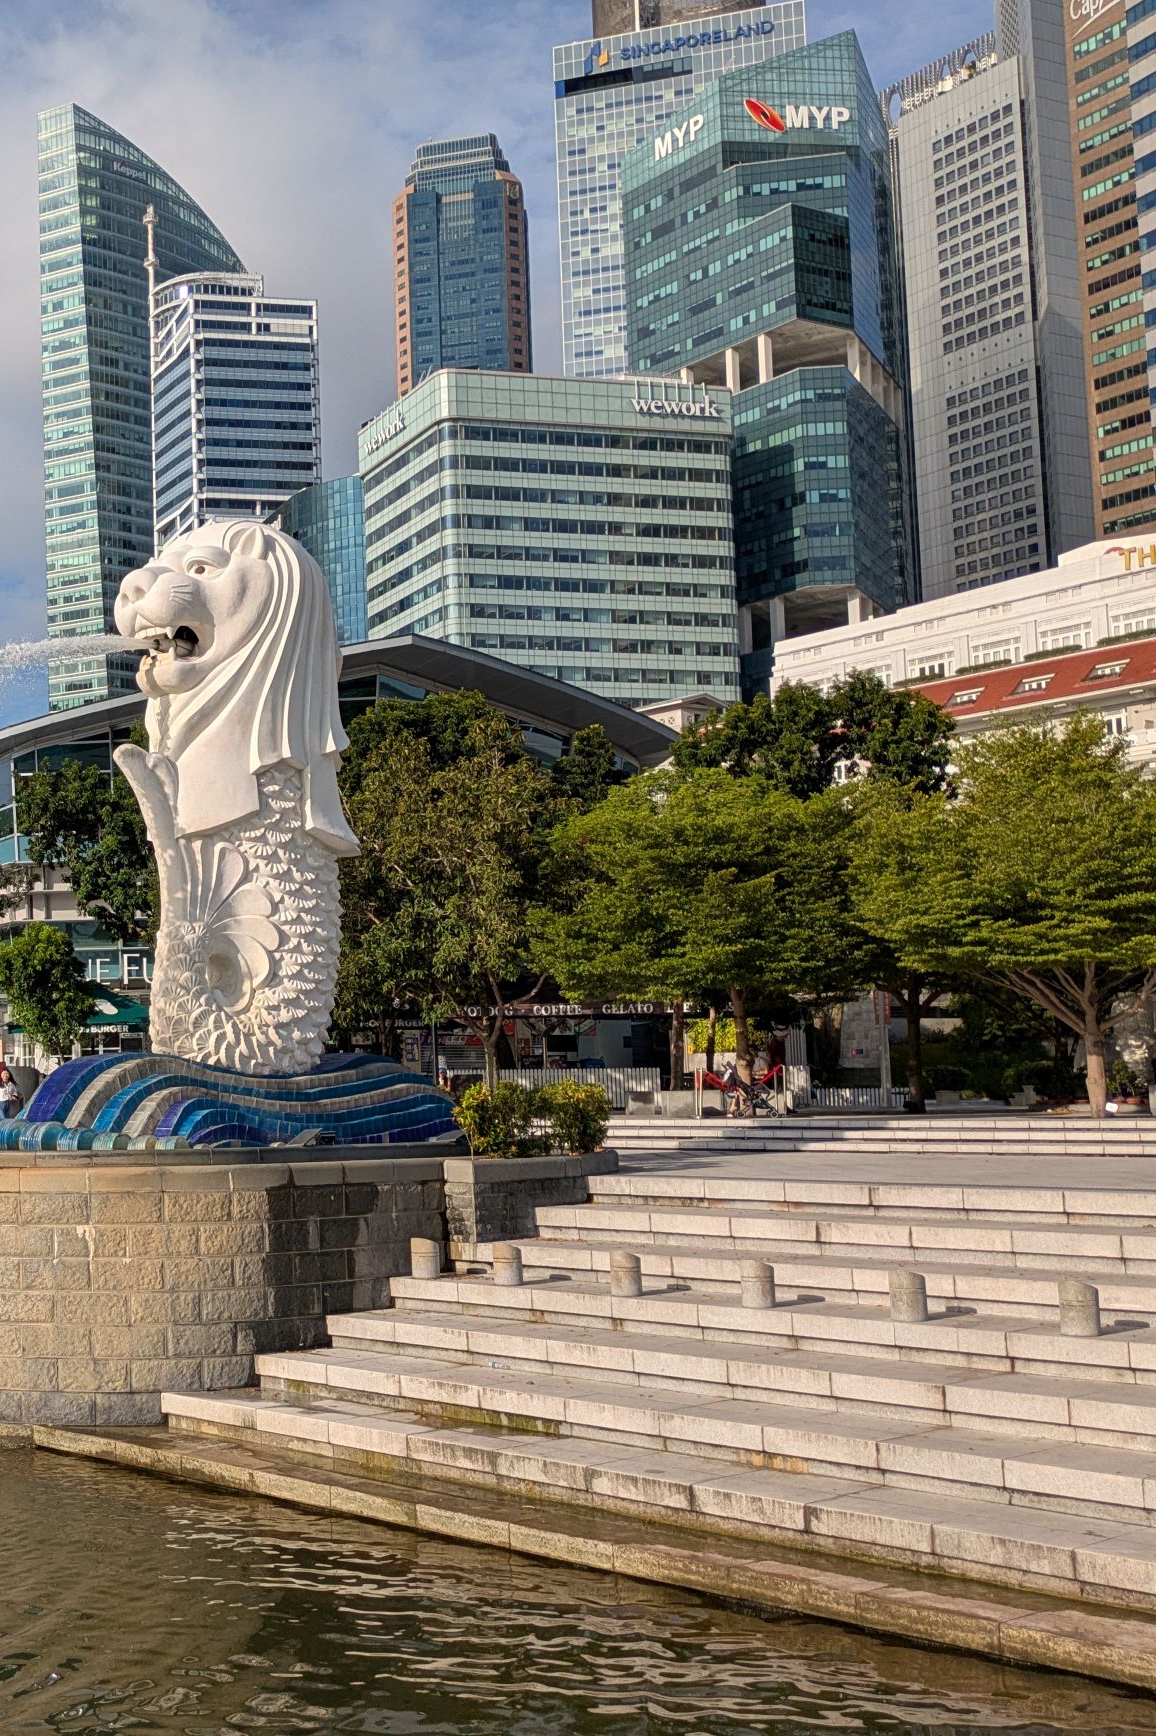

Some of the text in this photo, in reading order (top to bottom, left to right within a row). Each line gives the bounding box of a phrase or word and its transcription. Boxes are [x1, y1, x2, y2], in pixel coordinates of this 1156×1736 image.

[1070, 0, 1104, 19] Cap
[620, 20, 775, 60] SINGAPORELAND
[786, 105, 850, 129] MYP
[654, 113, 704, 161] MYP
[113, 161, 147, 180] Keppel
[631, 396, 720, 417] wework
[364, 411, 406, 455] wework
[533, 1004, 582, 1016] COFFEE
[602, 1002, 654, 1014] GELATO
[91, 1025, 129, 1033] BURGER
